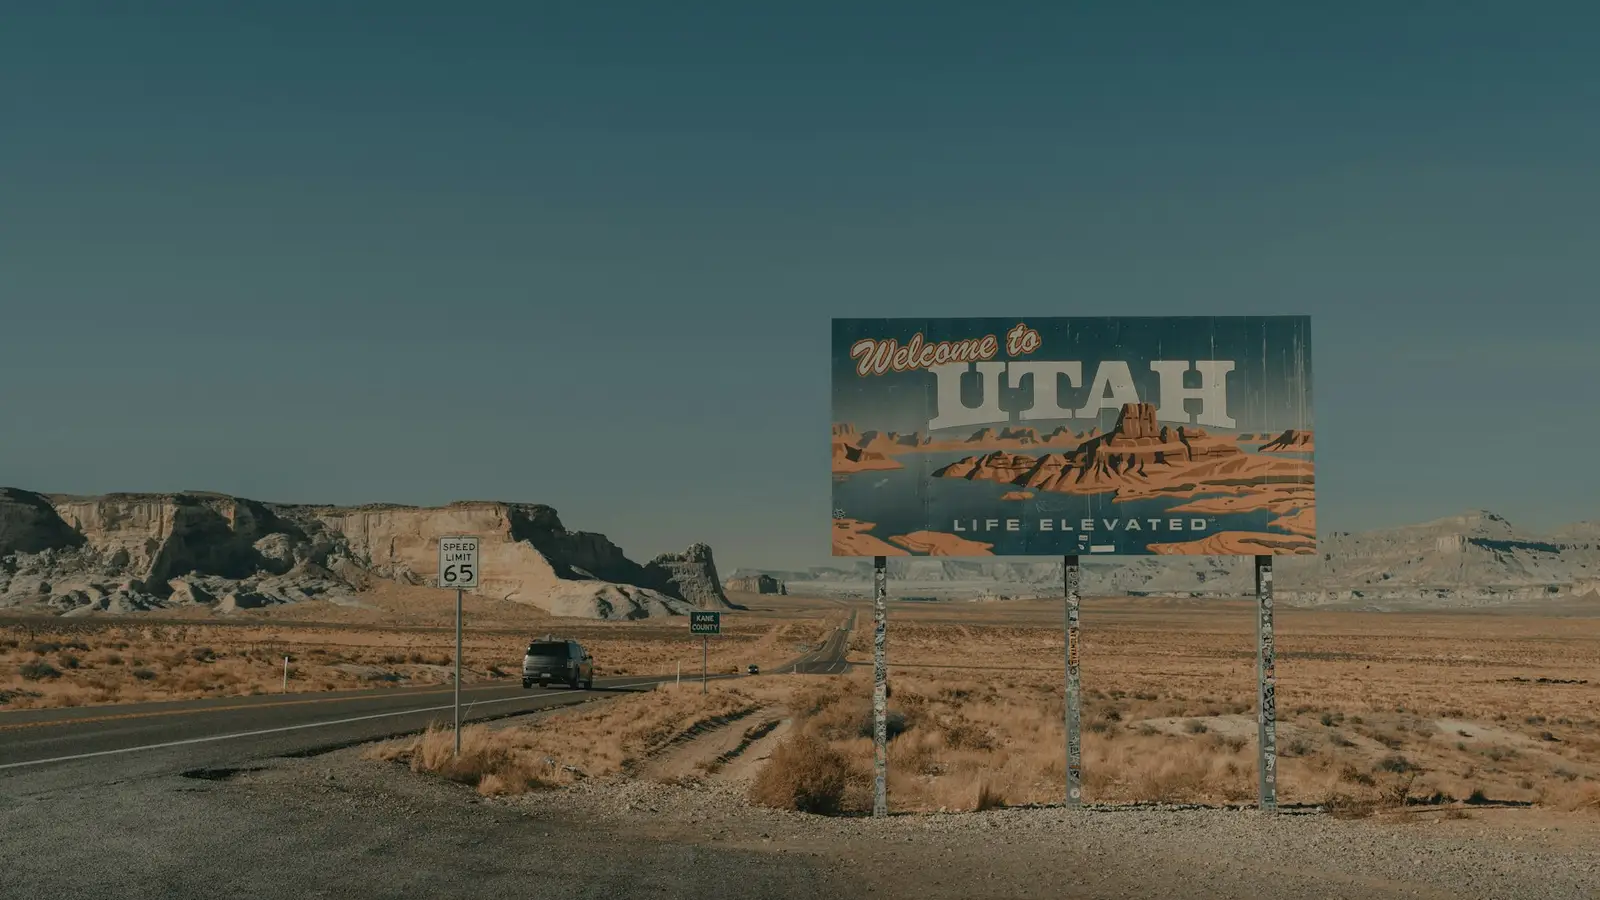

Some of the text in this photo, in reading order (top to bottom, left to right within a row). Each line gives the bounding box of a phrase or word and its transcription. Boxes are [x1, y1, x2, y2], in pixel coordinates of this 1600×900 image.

[851, 323, 1041, 377] Welcome to
[928, 360, 1236, 430] UTAH
[953, 518, 1020, 532] LIFE
[1039, 518, 1207, 531] ELEVATED
[443, 543, 476, 551] SPEED
[445, 553, 472, 562] LIMIT
[443, 564, 474, 582] 65
[692, 623, 719, 631] COUNTY
